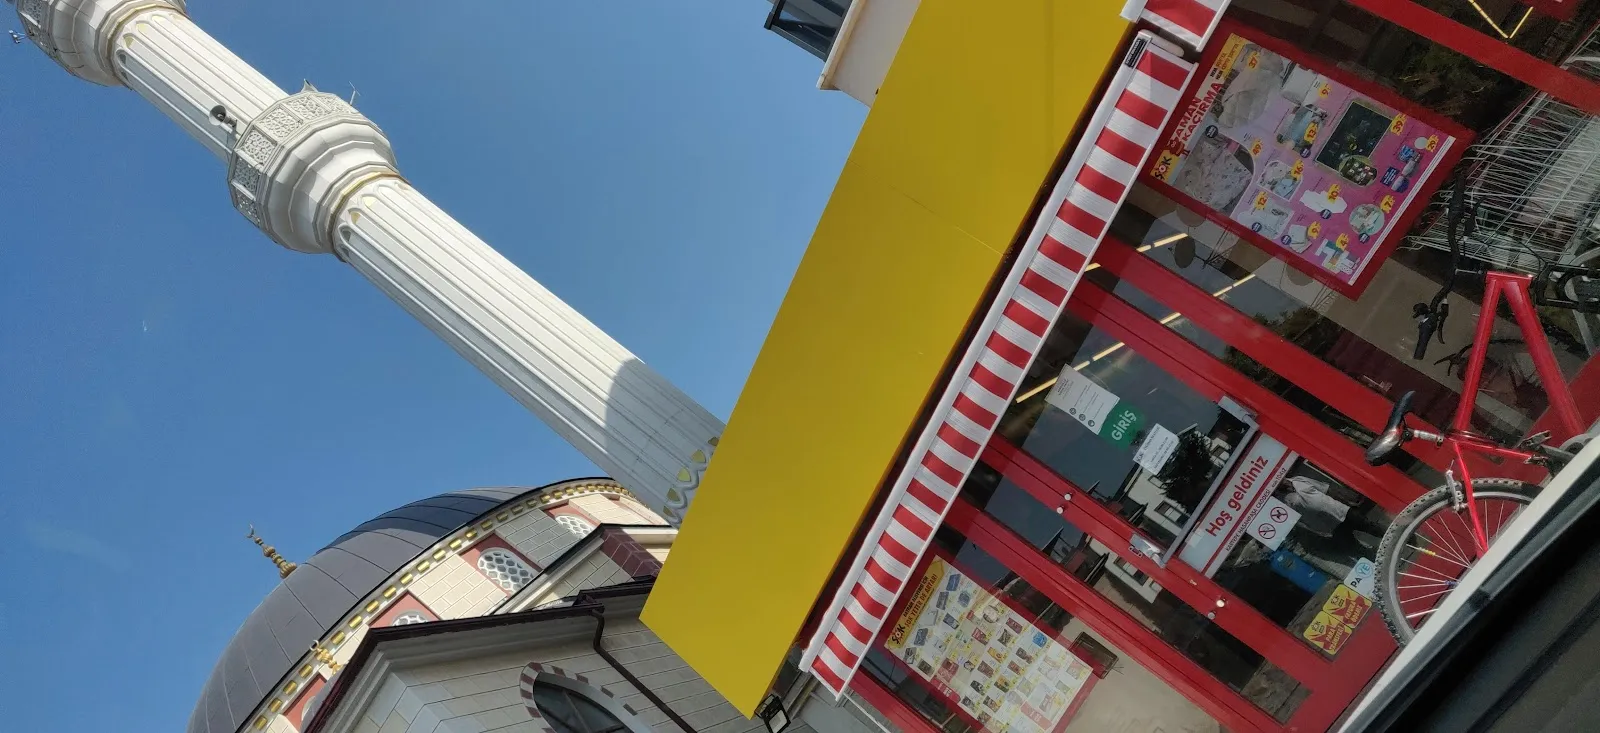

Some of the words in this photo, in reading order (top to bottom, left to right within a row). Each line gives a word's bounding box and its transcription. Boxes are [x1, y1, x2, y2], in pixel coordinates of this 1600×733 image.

[1174, 96, 1202, 138] AMAN
[1153, 156, 1172, 180] ŞOK
[1110, 410, 1137, 441] GİRİŞ
[1205, 510, 1232, 537] Hoş
[1227, 456, 1268, 511] geldiniz
[1237, 507, 1258, 534] HASANPAŞA
[1254, 488, 1270, 508] CADDESİ
[909, 600, 923, 616] YETER
[919, 592, 927, 600] DE
[889, 623, 908, 644] ŞOK
